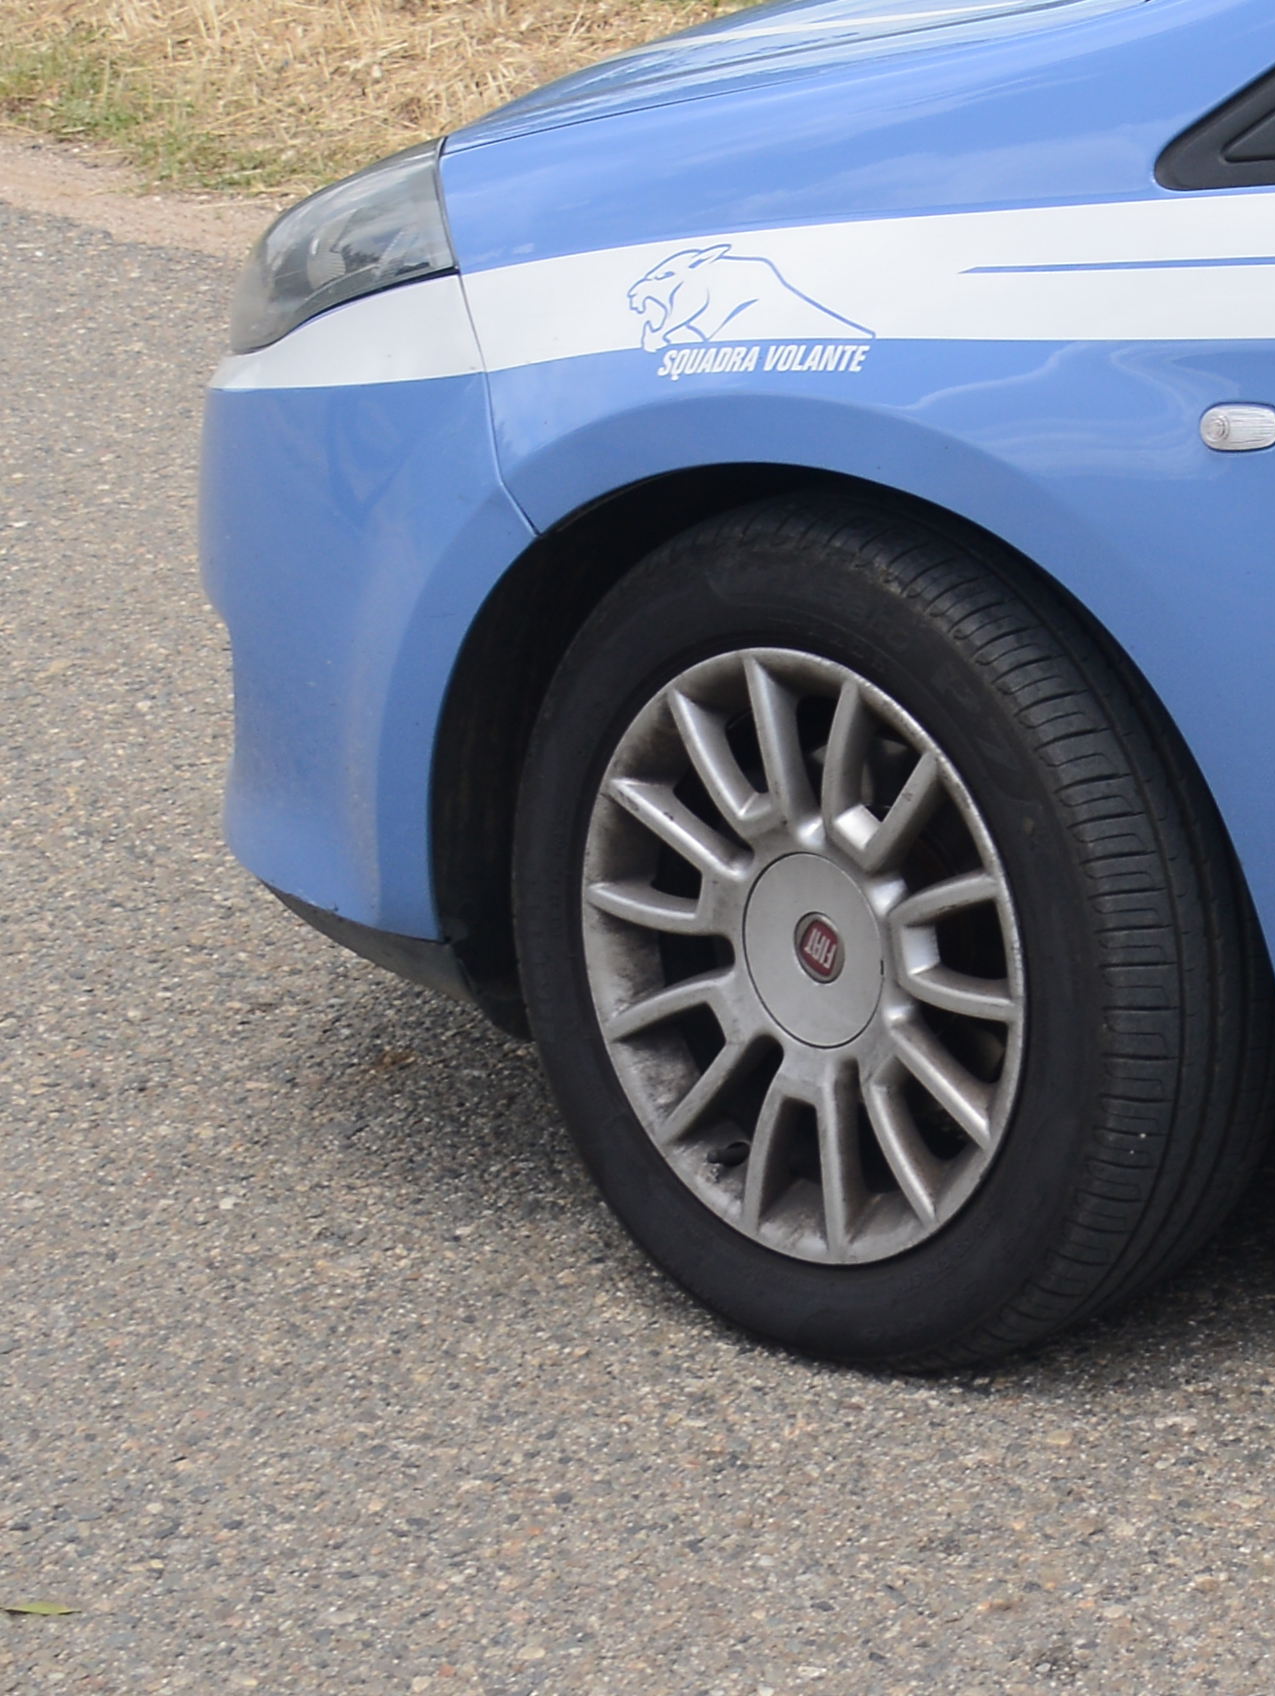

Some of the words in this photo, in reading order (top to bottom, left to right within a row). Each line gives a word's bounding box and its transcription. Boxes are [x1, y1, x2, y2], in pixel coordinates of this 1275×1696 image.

[658, 346, 760, 380] SQUADRA
[763, 344, 870, 373] VOLANTE
[803, 928, 837, 969] FIAT
